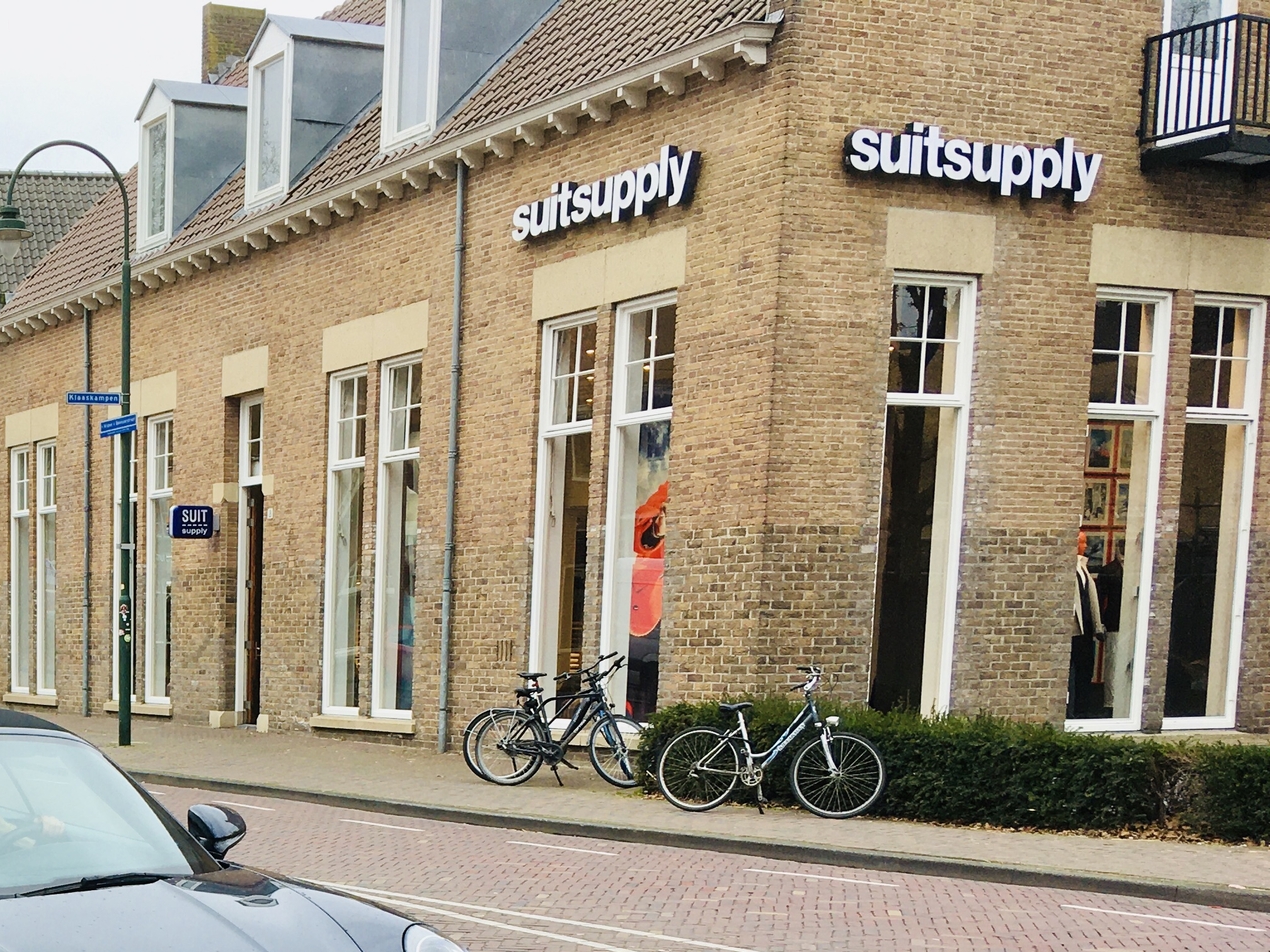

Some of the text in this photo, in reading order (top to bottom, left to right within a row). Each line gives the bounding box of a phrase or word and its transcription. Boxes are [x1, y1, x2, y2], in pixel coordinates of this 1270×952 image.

[849, 121, 1103, 203] suitsupply
[511, 144, 696, 242] suitsupply
[181, 509, 208, 523] SUIT
[181, 528, 208, 536] supply
